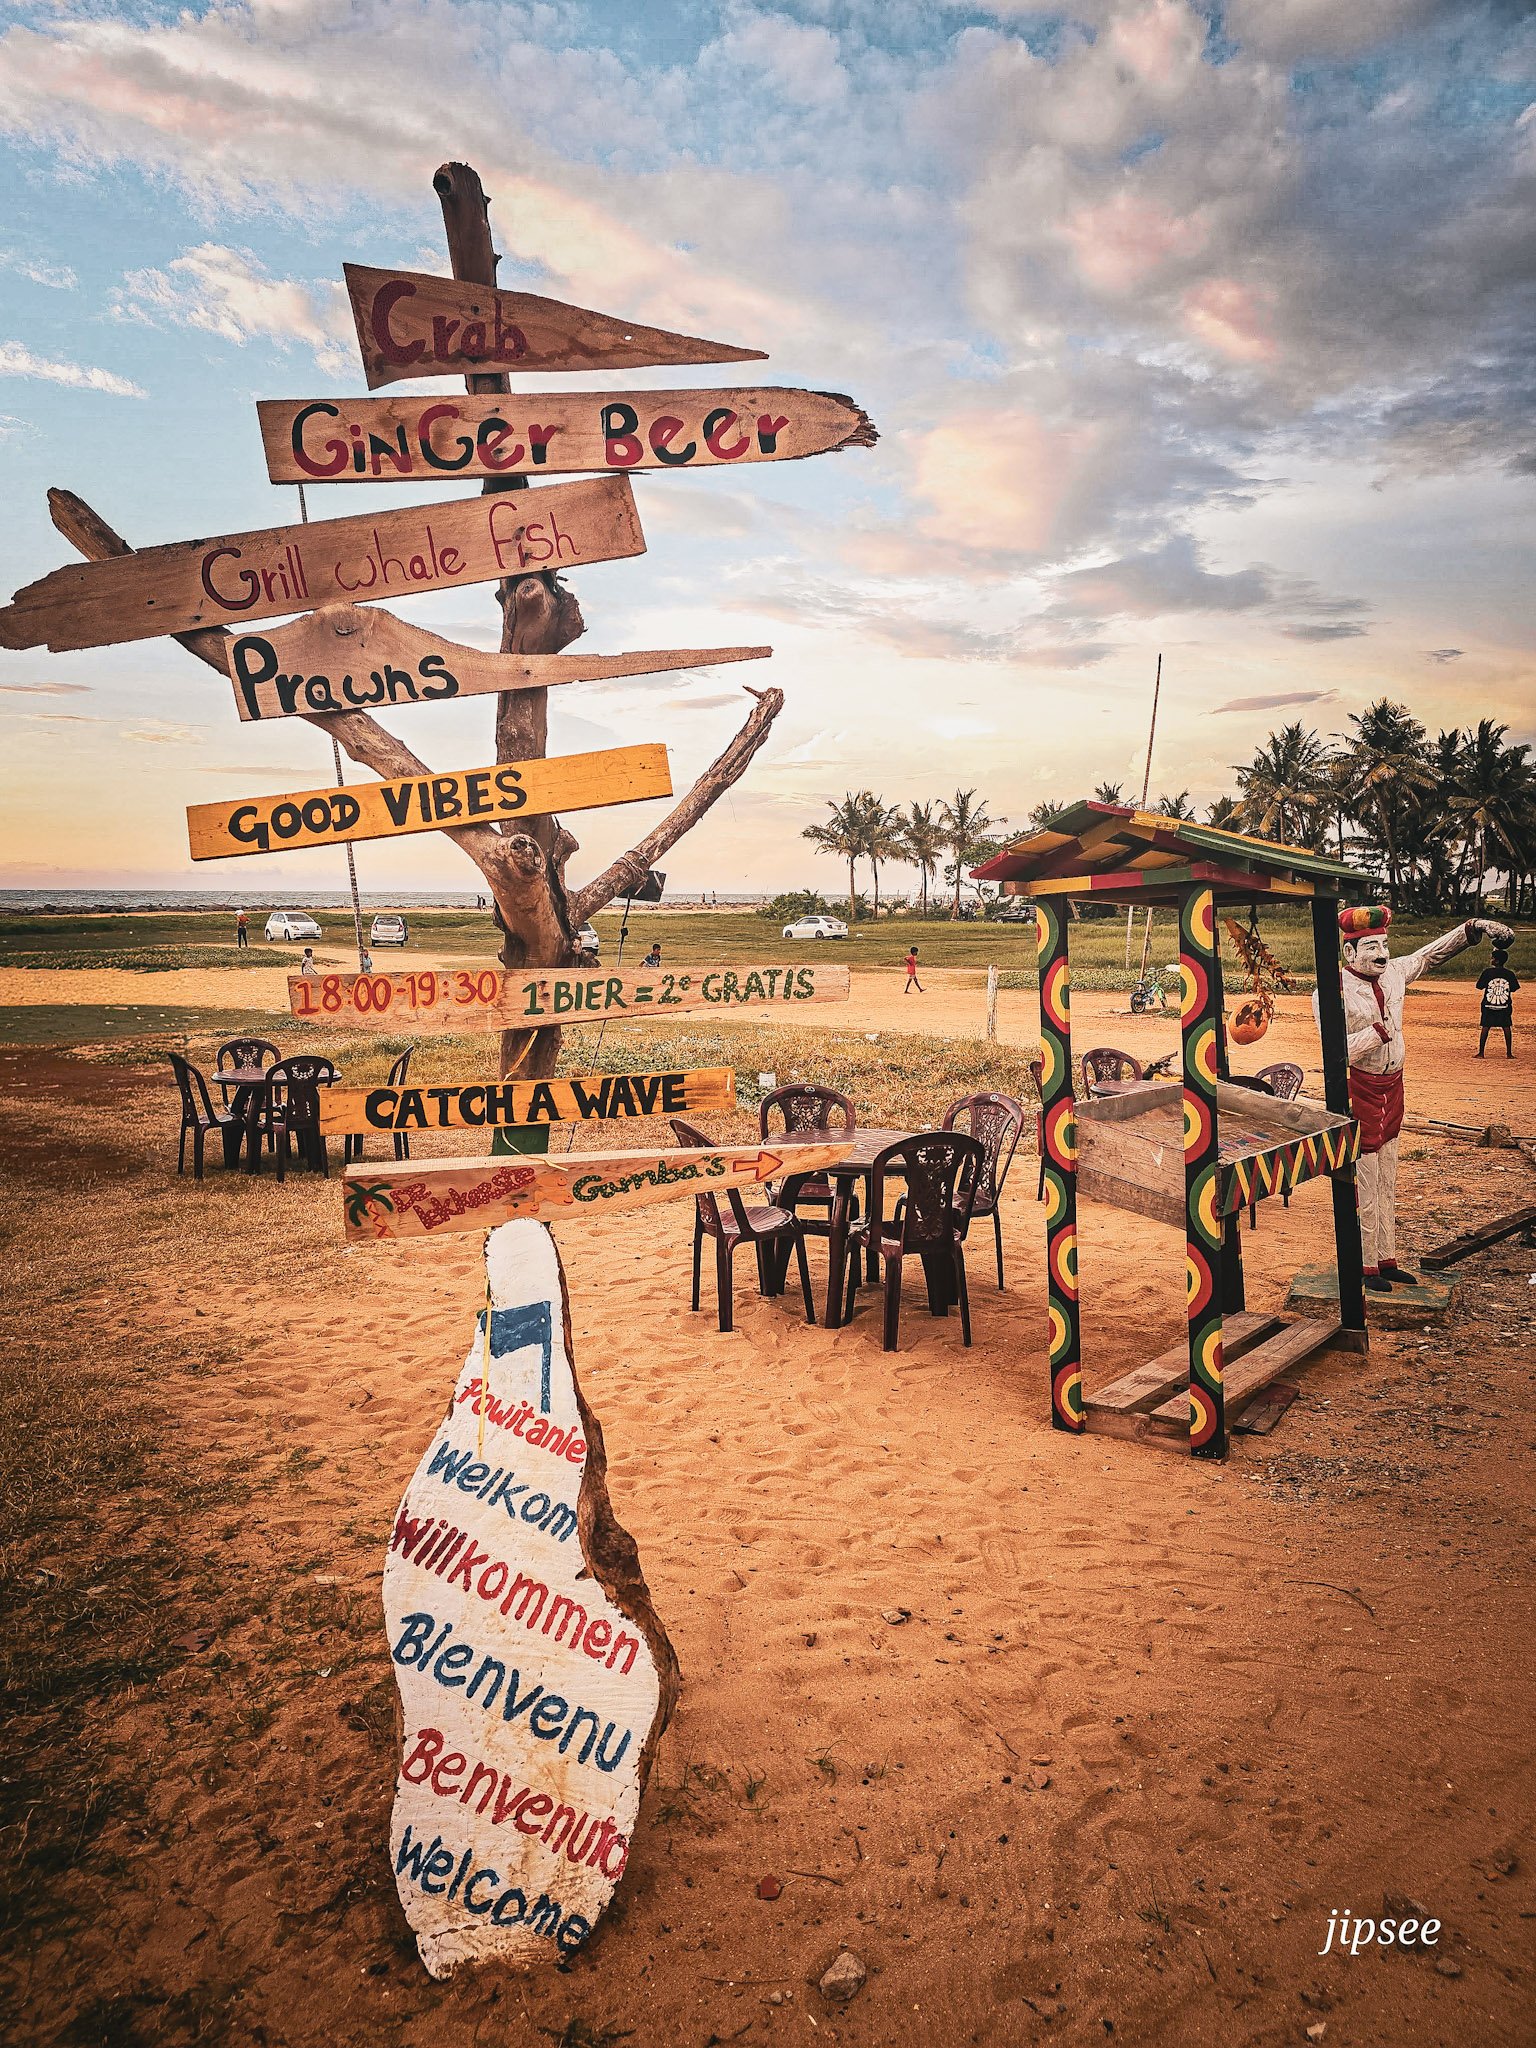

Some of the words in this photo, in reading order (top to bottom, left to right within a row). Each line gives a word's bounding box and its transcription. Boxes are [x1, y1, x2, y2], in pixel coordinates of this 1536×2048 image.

[370, 279, 527, 363] Crab
[600, 403, 790, 467] Beer
[202, 545, 310, 611] Grill
[335, 525, 467, 590] whale
[233, 636, 459, 719] Prawns
[228, 794, 361, 850] GOOD
[380, 770, 528, 824] VIBES
[554, 977, 629, 1013] BIER
[701, 967, 816, 1003] GRATIS
[364, 1083, 516, 1129] CATCH
[525, 1082, 562, 1122] A
[570, 1073, 692, 1120] WAVE
[572, 1155, 727, 1202] Gamba's
[455, 1378, 588, 1463] Powitanie
[426, 1440, 578, 1543] Welkom
[402, 1728, 630, 1881] Benvenuto
